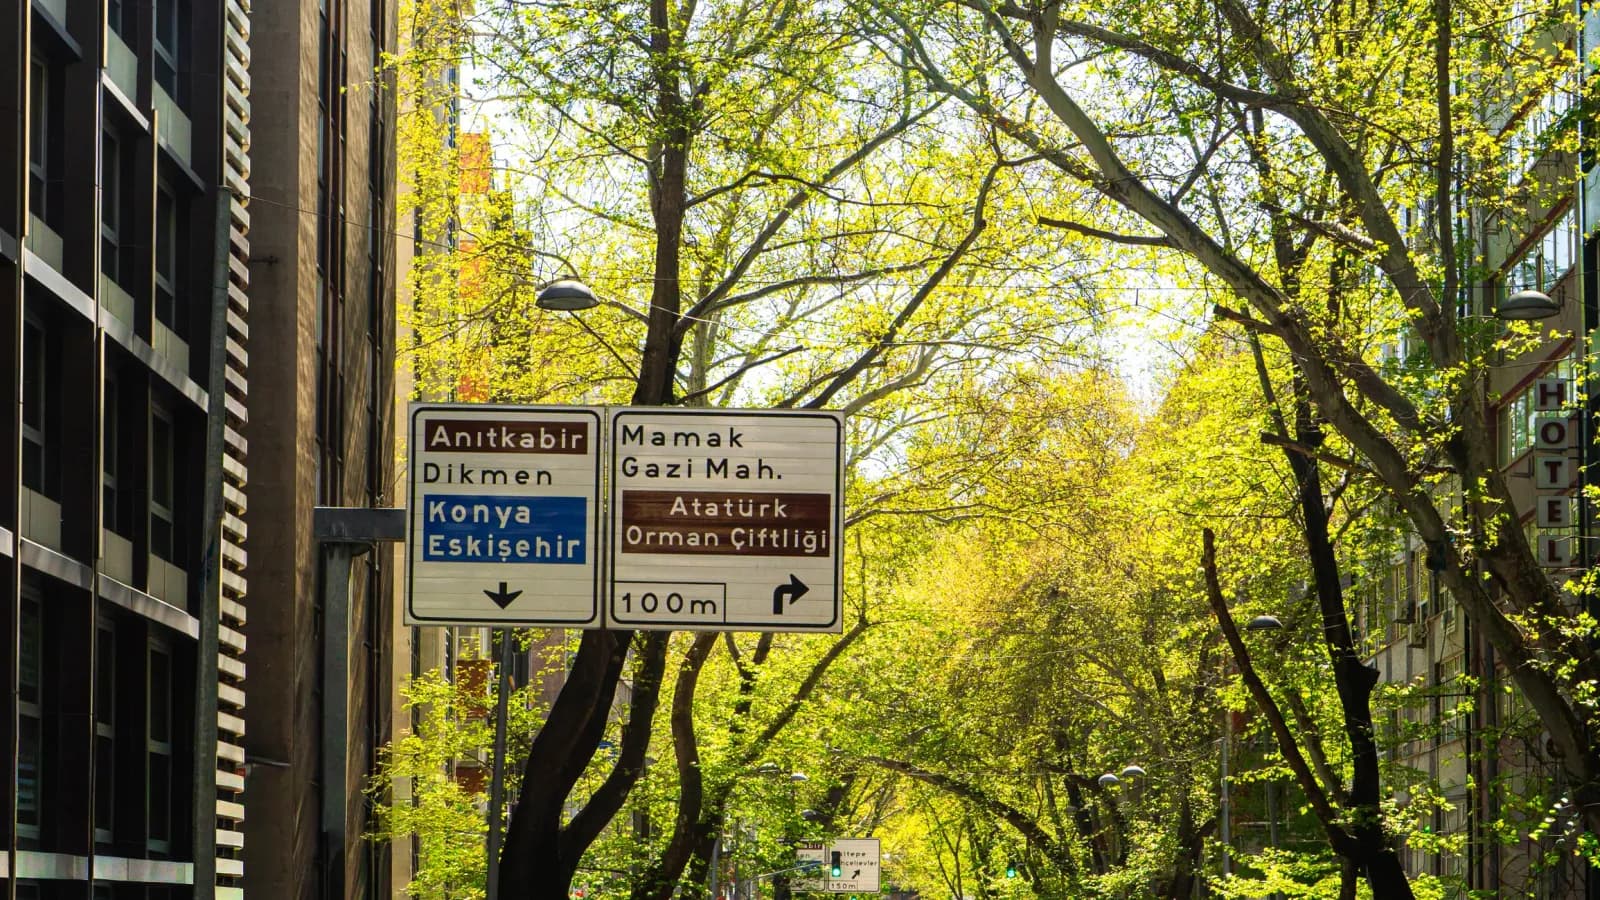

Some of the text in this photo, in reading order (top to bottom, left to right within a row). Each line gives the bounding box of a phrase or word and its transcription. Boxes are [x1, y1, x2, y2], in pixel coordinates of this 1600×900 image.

[431, 425, 583, 450] Anıtkabir
[622, 425, 743, 448] Mamak
[423, 463, 552, 485] Dikmen
[622, 457, 782, 480] Gazi Mah.
[1540, 383, 1565, 562] HOTEL
[429, 501, 531, 528] Konya
[670, 497, 788, 518] Atatürk
[428, 534, 581, 562] Eskişehir
[626, 526, 827, 553] Orman Çiftliği
[622, 592, 717, 614] 100m
